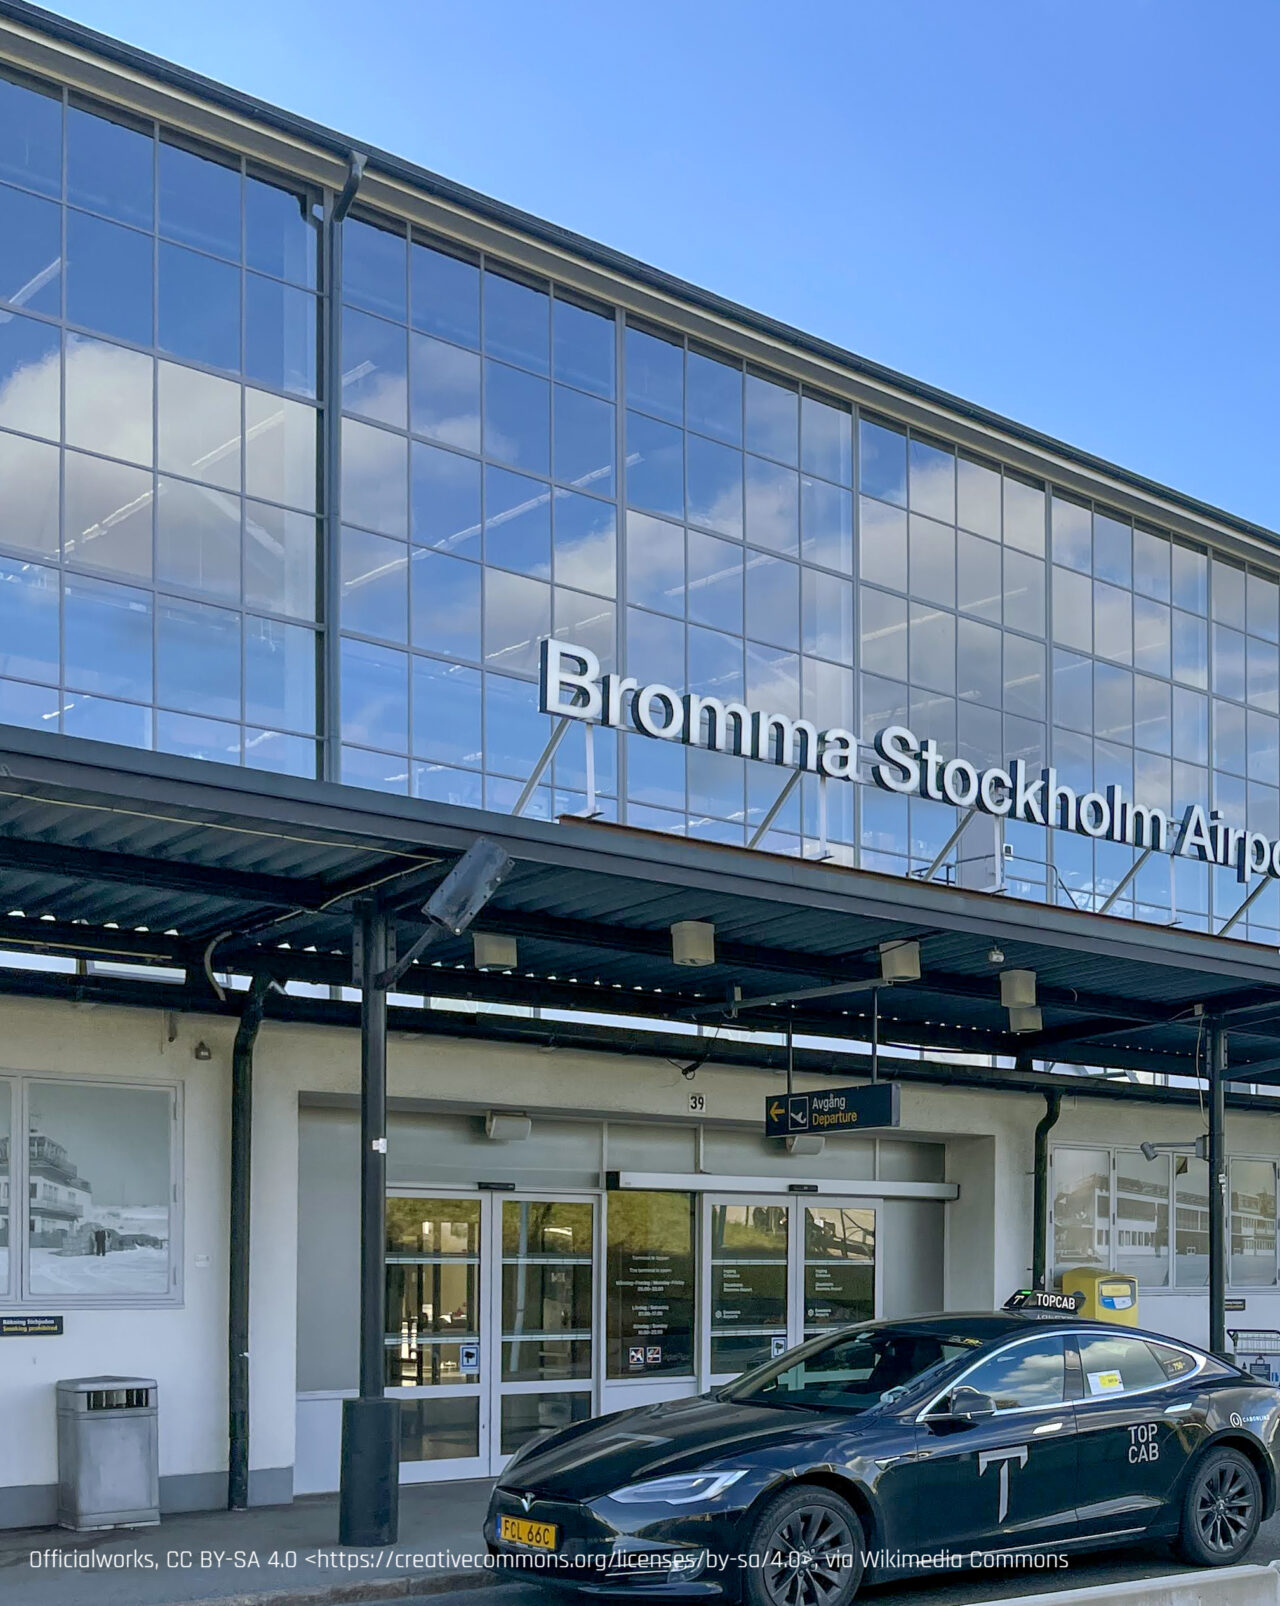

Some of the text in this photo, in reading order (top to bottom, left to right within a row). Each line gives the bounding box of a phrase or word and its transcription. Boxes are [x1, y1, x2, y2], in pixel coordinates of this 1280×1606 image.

[539, 638, 859, 781] Bromma
[871, 725, 1168, 850] Stockholm
[690, 1095, 704, 1110] 39
[812, 1094, 846, 1112] Avgång
[812, 1111, 858, 1127] Departure
[1036, 1293, 1076, 1310] TOPCAB
[1128, 1423, 1158, 1444] TOP
[1128, 1443, 1159, 1463] CAB
[504, 1519, 550, 1544] FCL 66C
